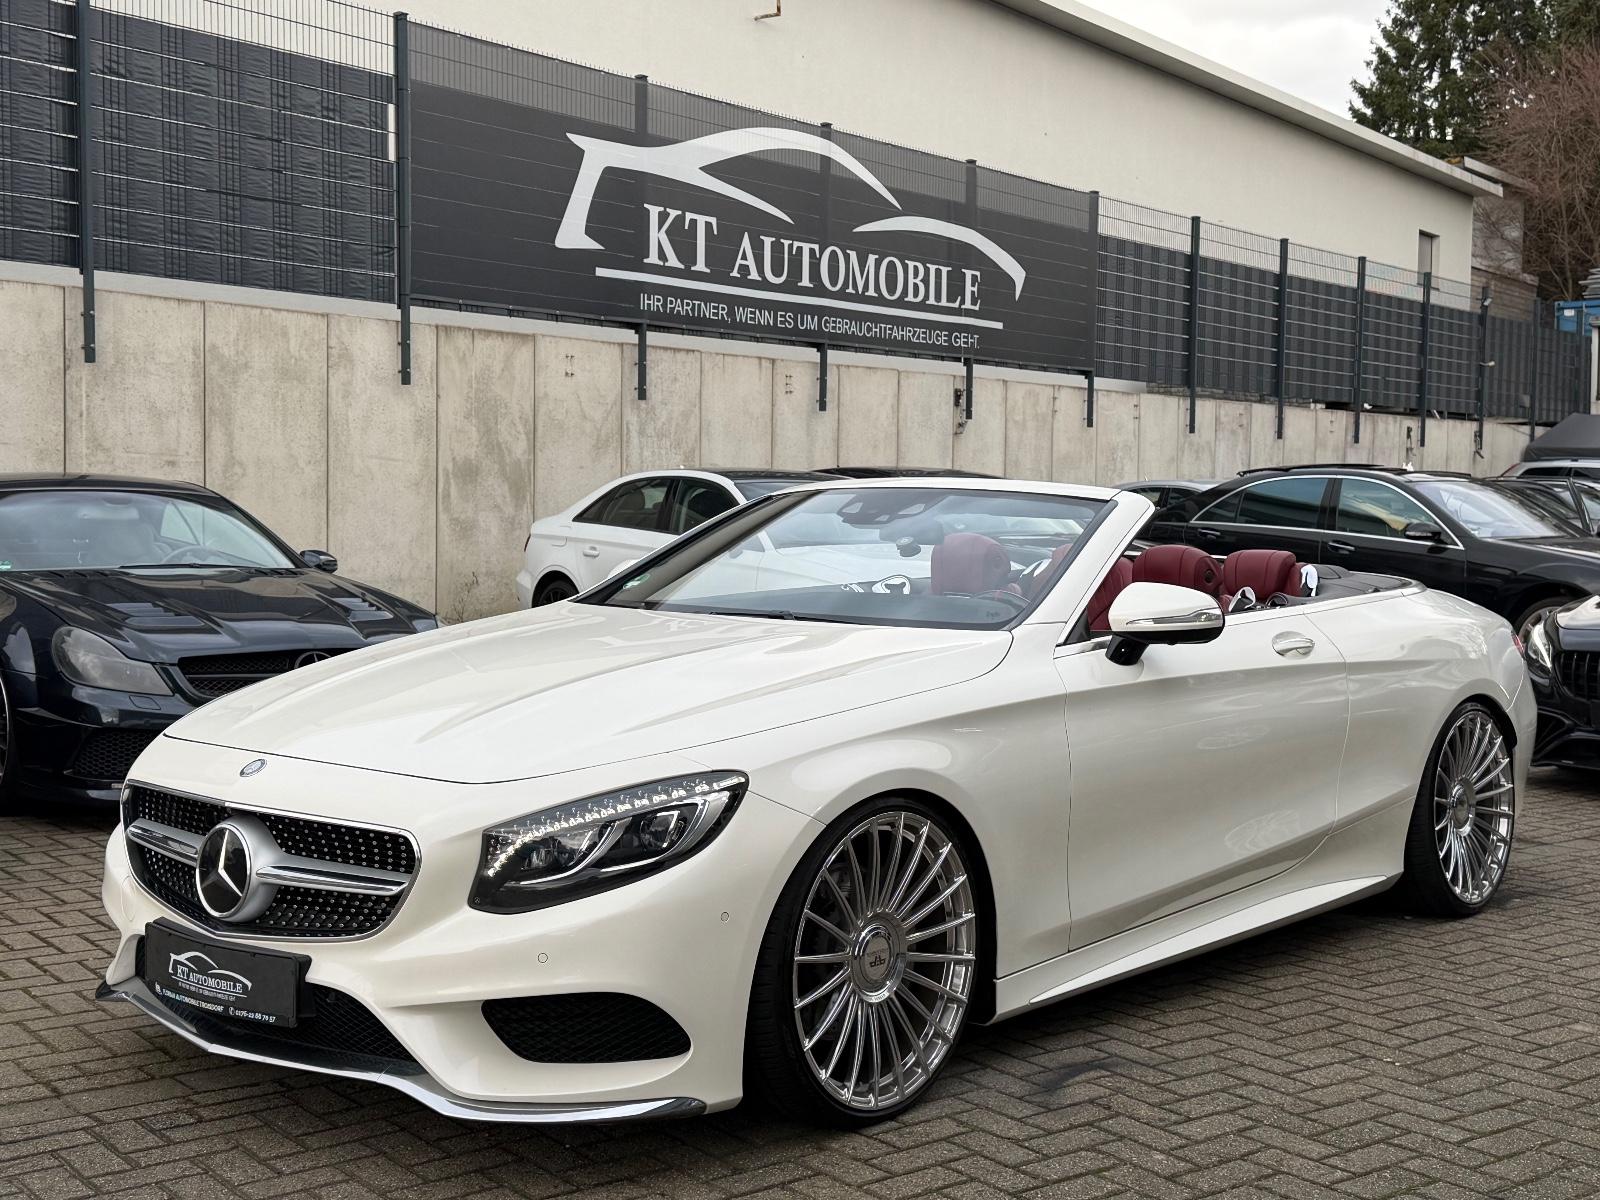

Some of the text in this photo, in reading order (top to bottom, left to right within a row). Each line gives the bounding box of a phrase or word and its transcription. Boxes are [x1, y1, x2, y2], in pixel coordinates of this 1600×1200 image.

[643, 203, 982, 311] KT AUTOMOBILE
[639, 293, 663, 313] IHR
[666, 296, 731, 324] PARTNER,
[734, 305, 774, 326] WENN
[777, 311, 794, 329] ES
[797, 313, 818, 331] UM
[821, 316, 949, 346] GEBRAUCHTFAHRZEUGE
[176, 964, 189, 980] KT
[189, 972, 243, 993] AUTOMOBILE
